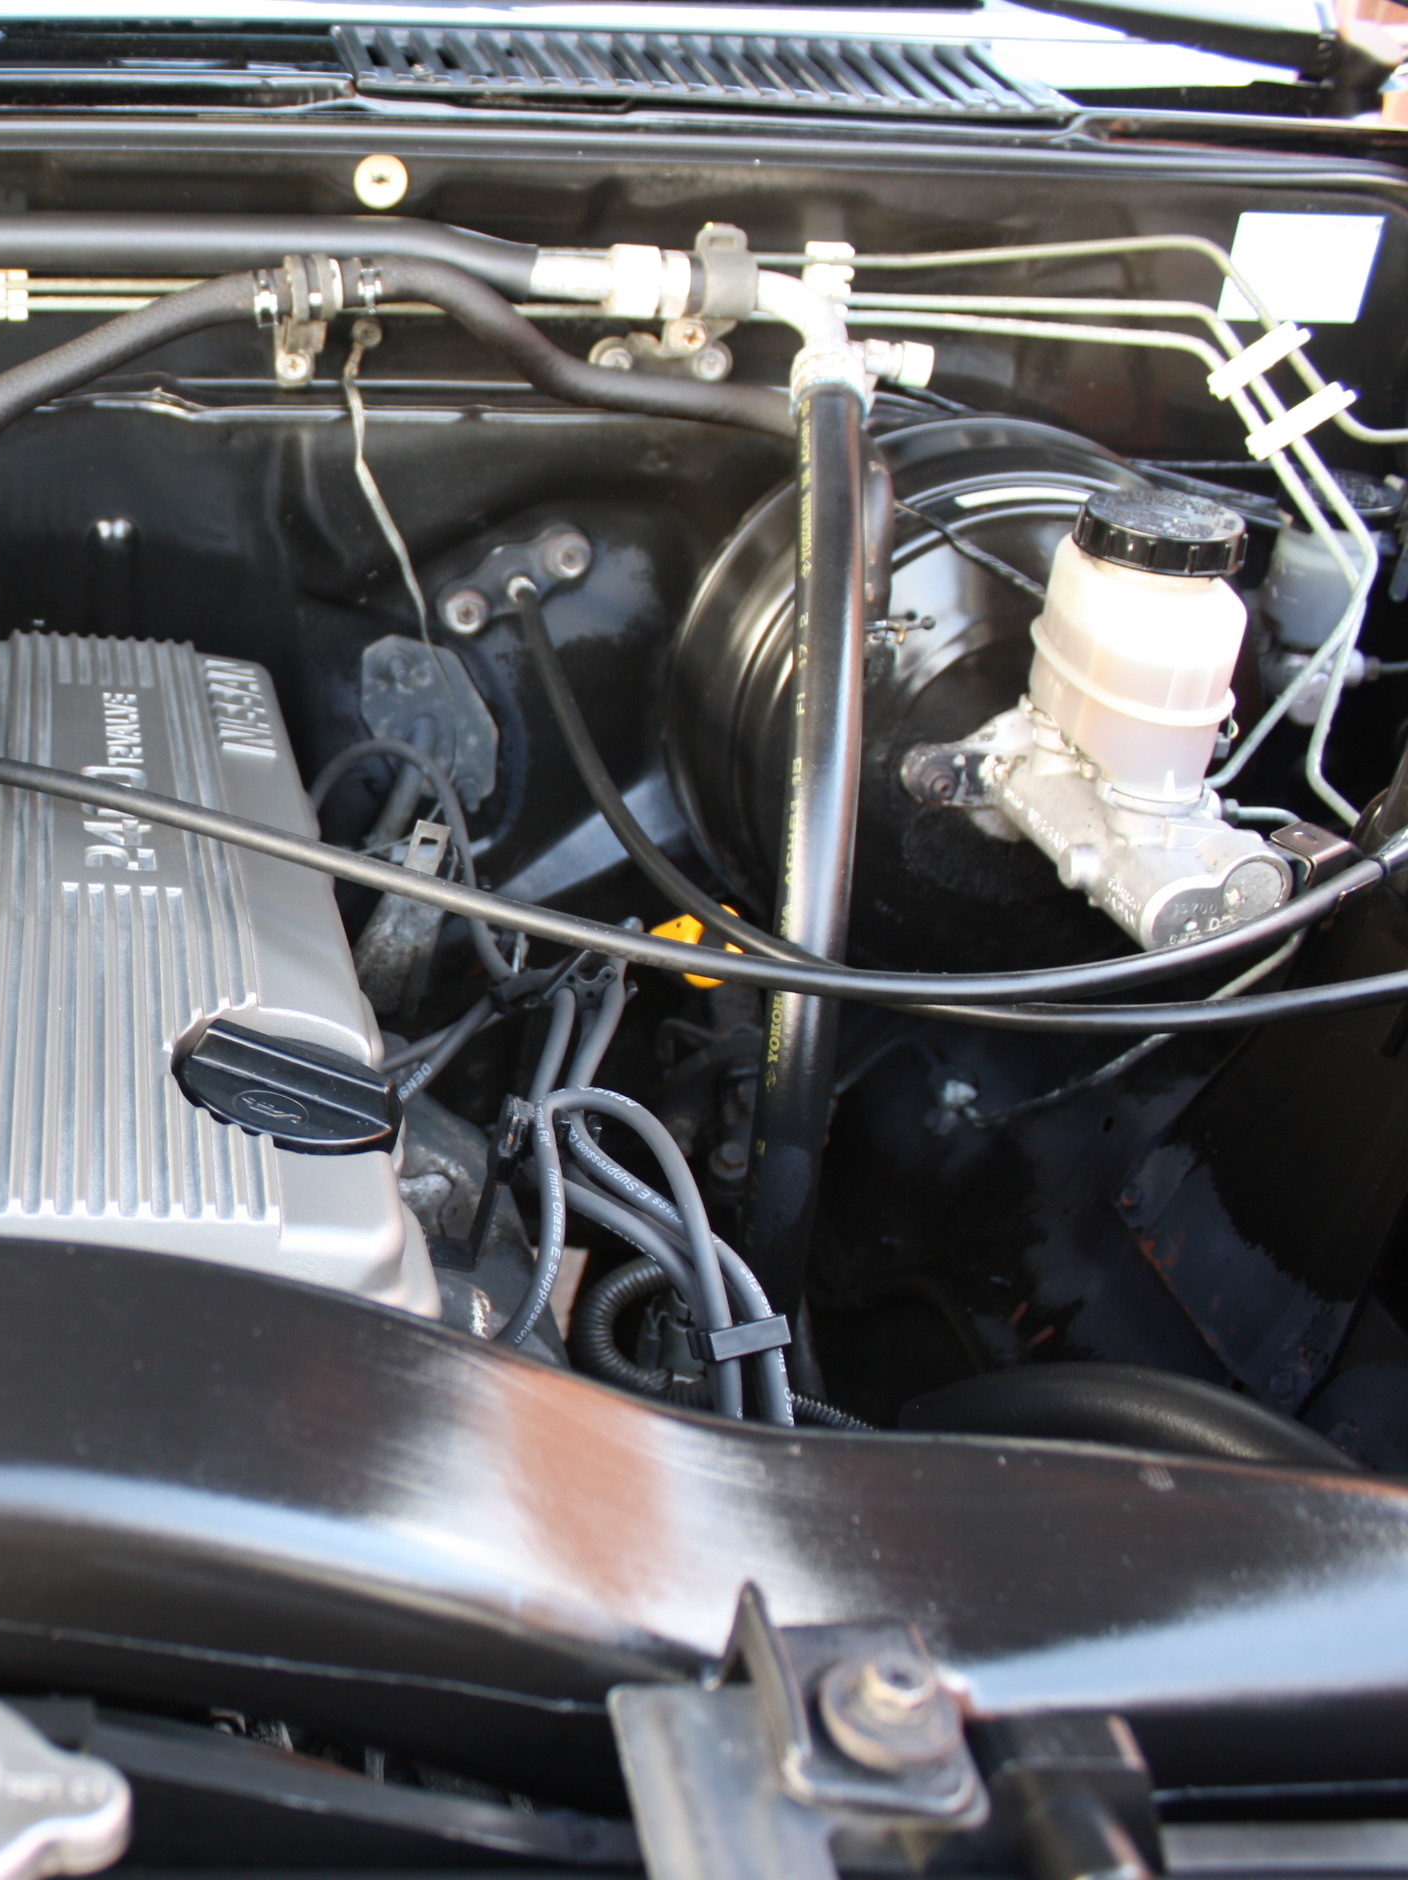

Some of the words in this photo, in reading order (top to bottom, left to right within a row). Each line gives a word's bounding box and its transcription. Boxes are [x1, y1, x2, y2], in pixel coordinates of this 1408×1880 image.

[204, 658, 277, 758] NISSAN
[398, 1062, 432, 1099] DENS
[575, 1139, 640, 1192] Suppression
[636, 1188, 652, 1200] E
[551, 1201, 564, 1243] Class
[550, 1247, 562, 1260] E
[514, 1263, 559, 1345] Suppression
